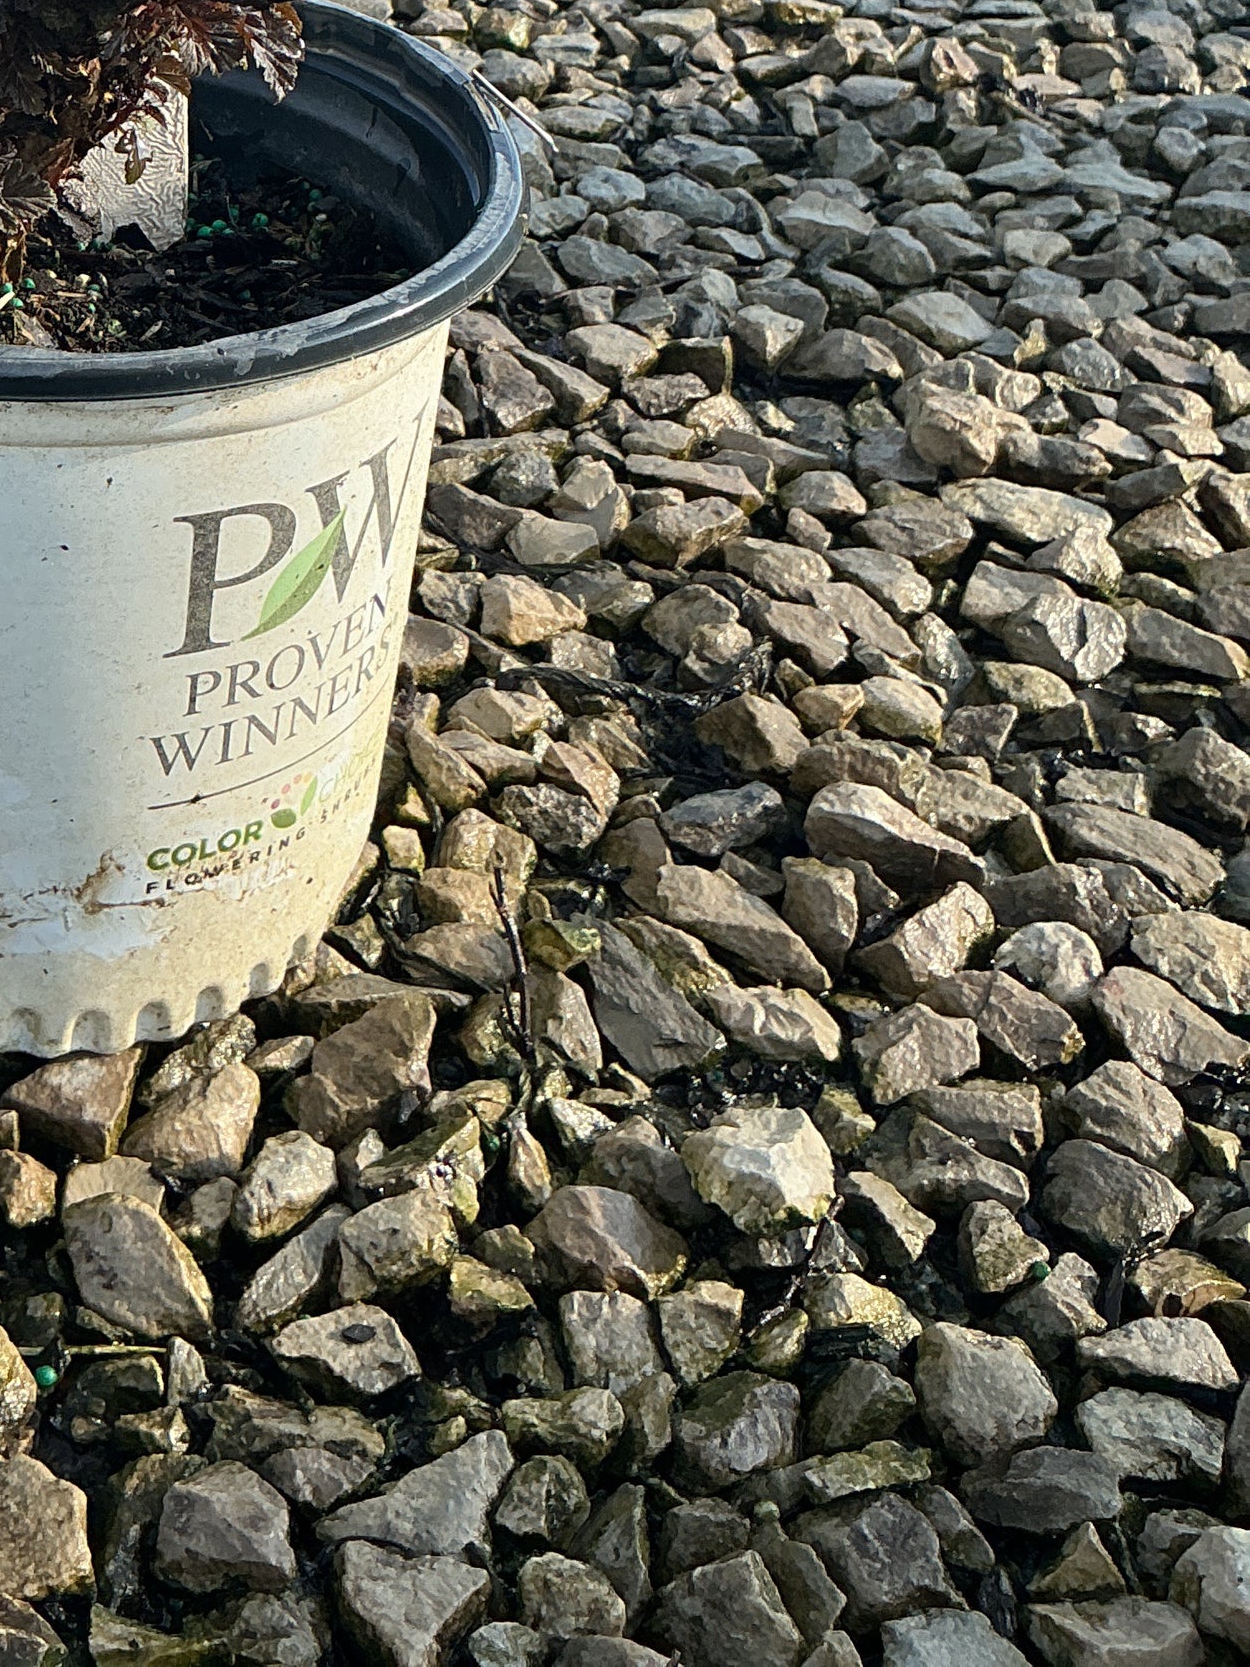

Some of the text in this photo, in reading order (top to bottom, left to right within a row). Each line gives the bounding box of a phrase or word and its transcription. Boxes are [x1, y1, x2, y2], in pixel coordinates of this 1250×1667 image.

[162, 396, 431, 658] PW
[182, 572, 393, 717] PROVEN
[145, 826, 307, 895] FLOWERING
[146, 819, 264, 871] COLOR
